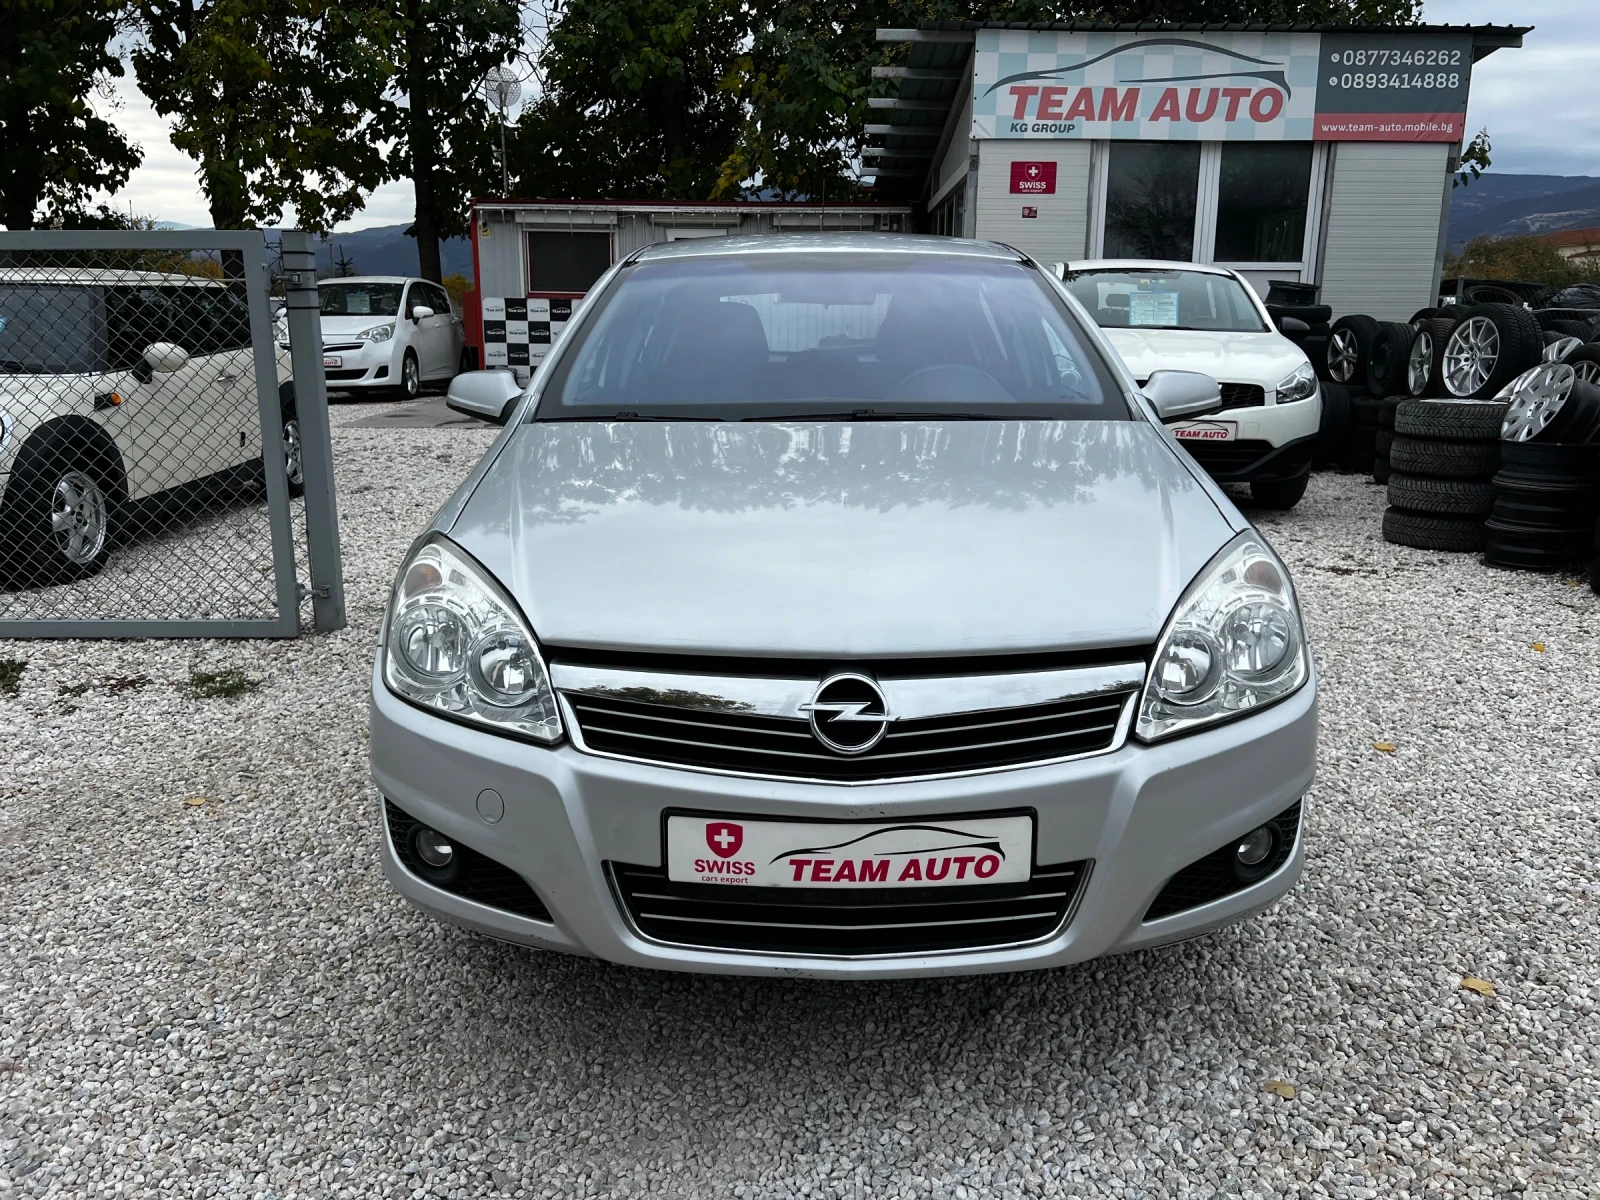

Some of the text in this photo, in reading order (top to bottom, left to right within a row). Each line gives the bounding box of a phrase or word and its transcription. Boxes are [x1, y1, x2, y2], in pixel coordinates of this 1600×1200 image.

[1343, 50, 1461, 66] 0877346262
[1341, 73, 1459, 89] 0893414888
[1009, 85, 1284, 123] TEAM AUTO
[1010, 122, 1075, 133] KG GROUP
[1321, 122, 1453, 133] www.team-auto.mobile.bg
[1019, 181, 1047, 189] SWISS
[694, 859, 756, 876] SWISS
[788, 854, 1000, 882] TEAM AUTO
[720, 876, 749, 884] export
